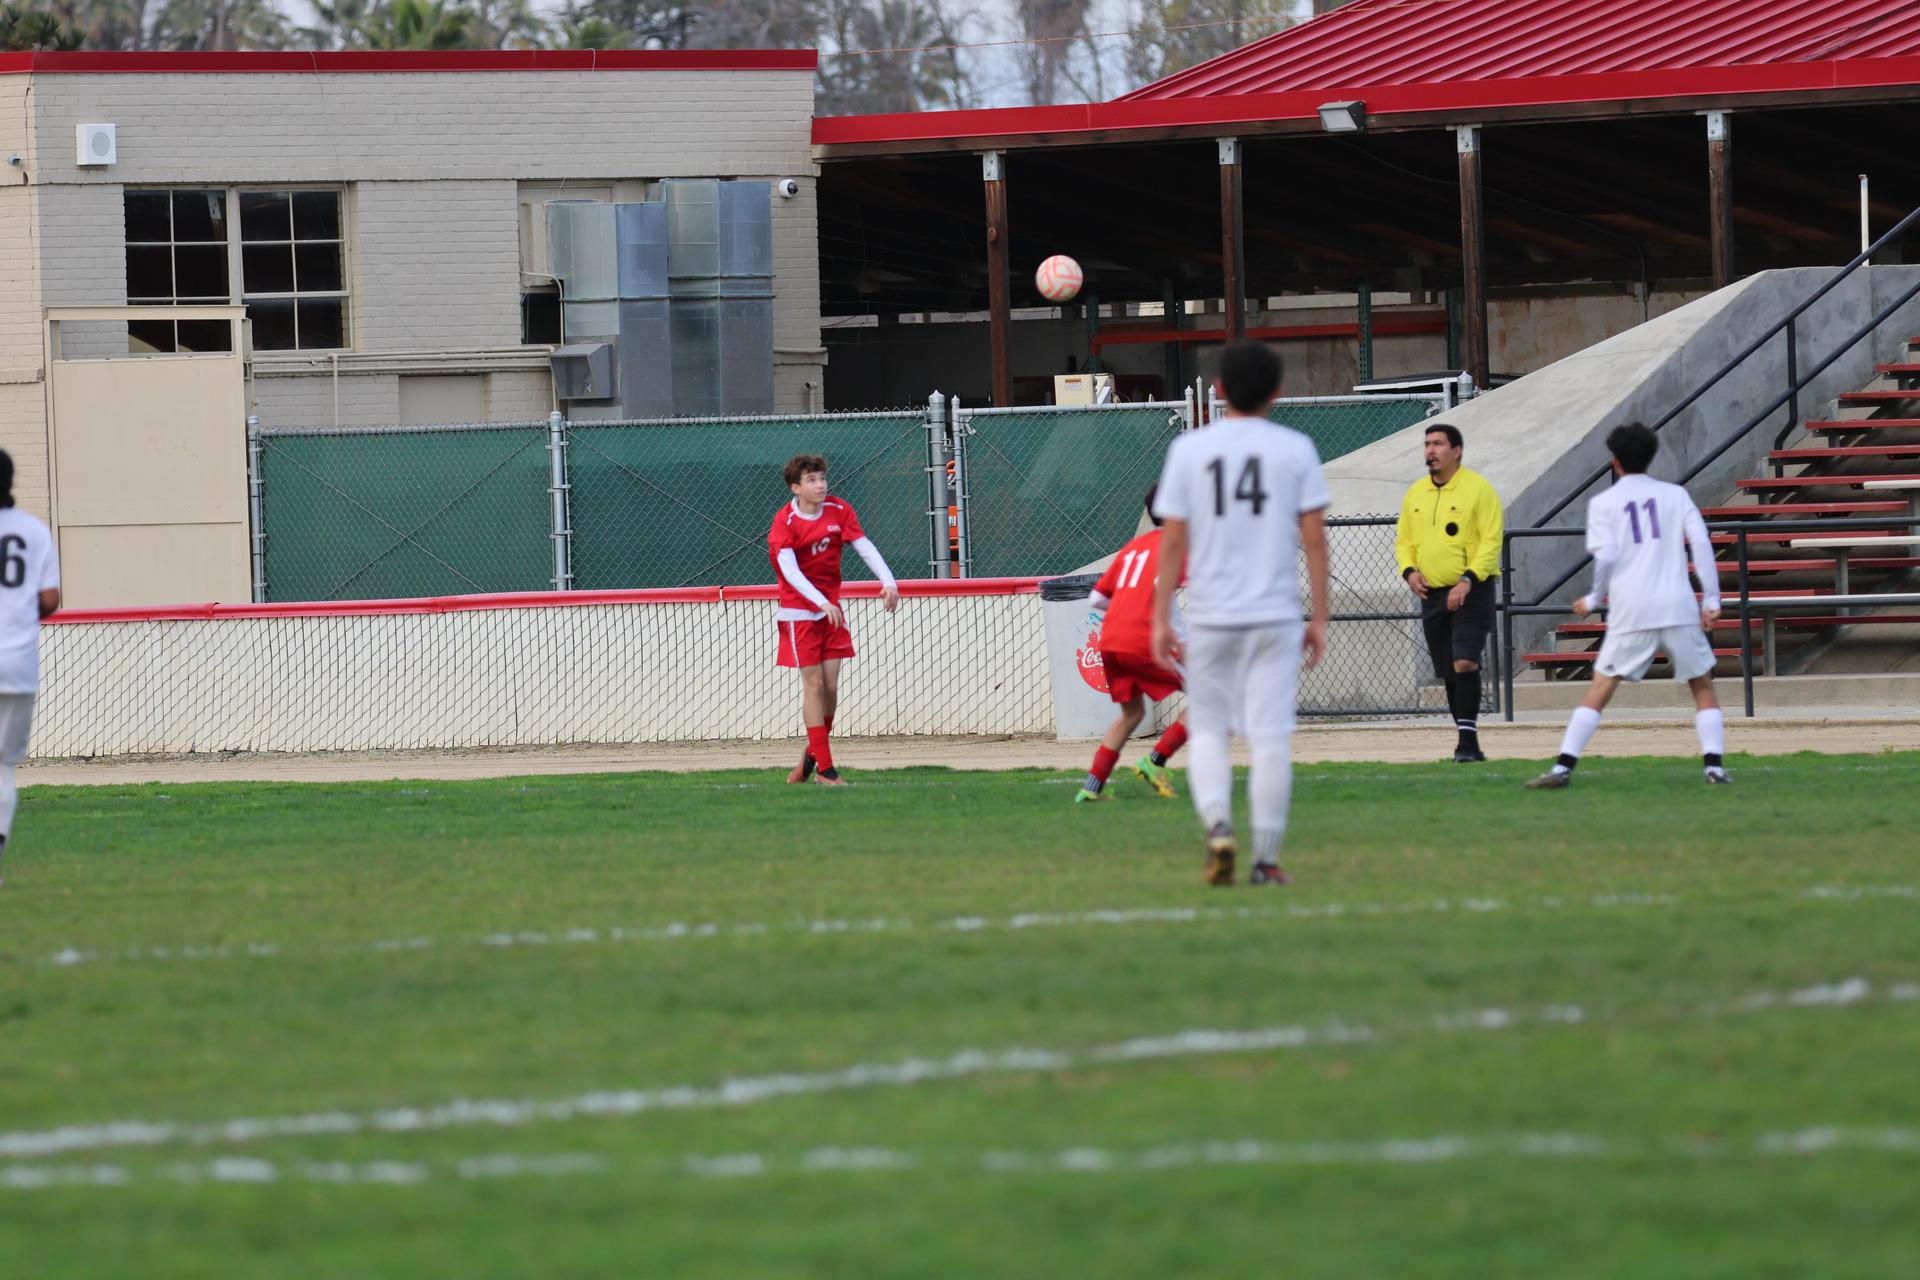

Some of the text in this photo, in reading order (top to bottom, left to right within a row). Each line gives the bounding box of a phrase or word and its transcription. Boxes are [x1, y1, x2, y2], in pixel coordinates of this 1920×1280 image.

[1206, 455, 1268, 517] 14
[1623, 497, 1661, 544] 11
[0, 534, 26, 588] 6
[1116, 549, 1150, 588] 11
[1081, 647, 1104, 668] Coc
